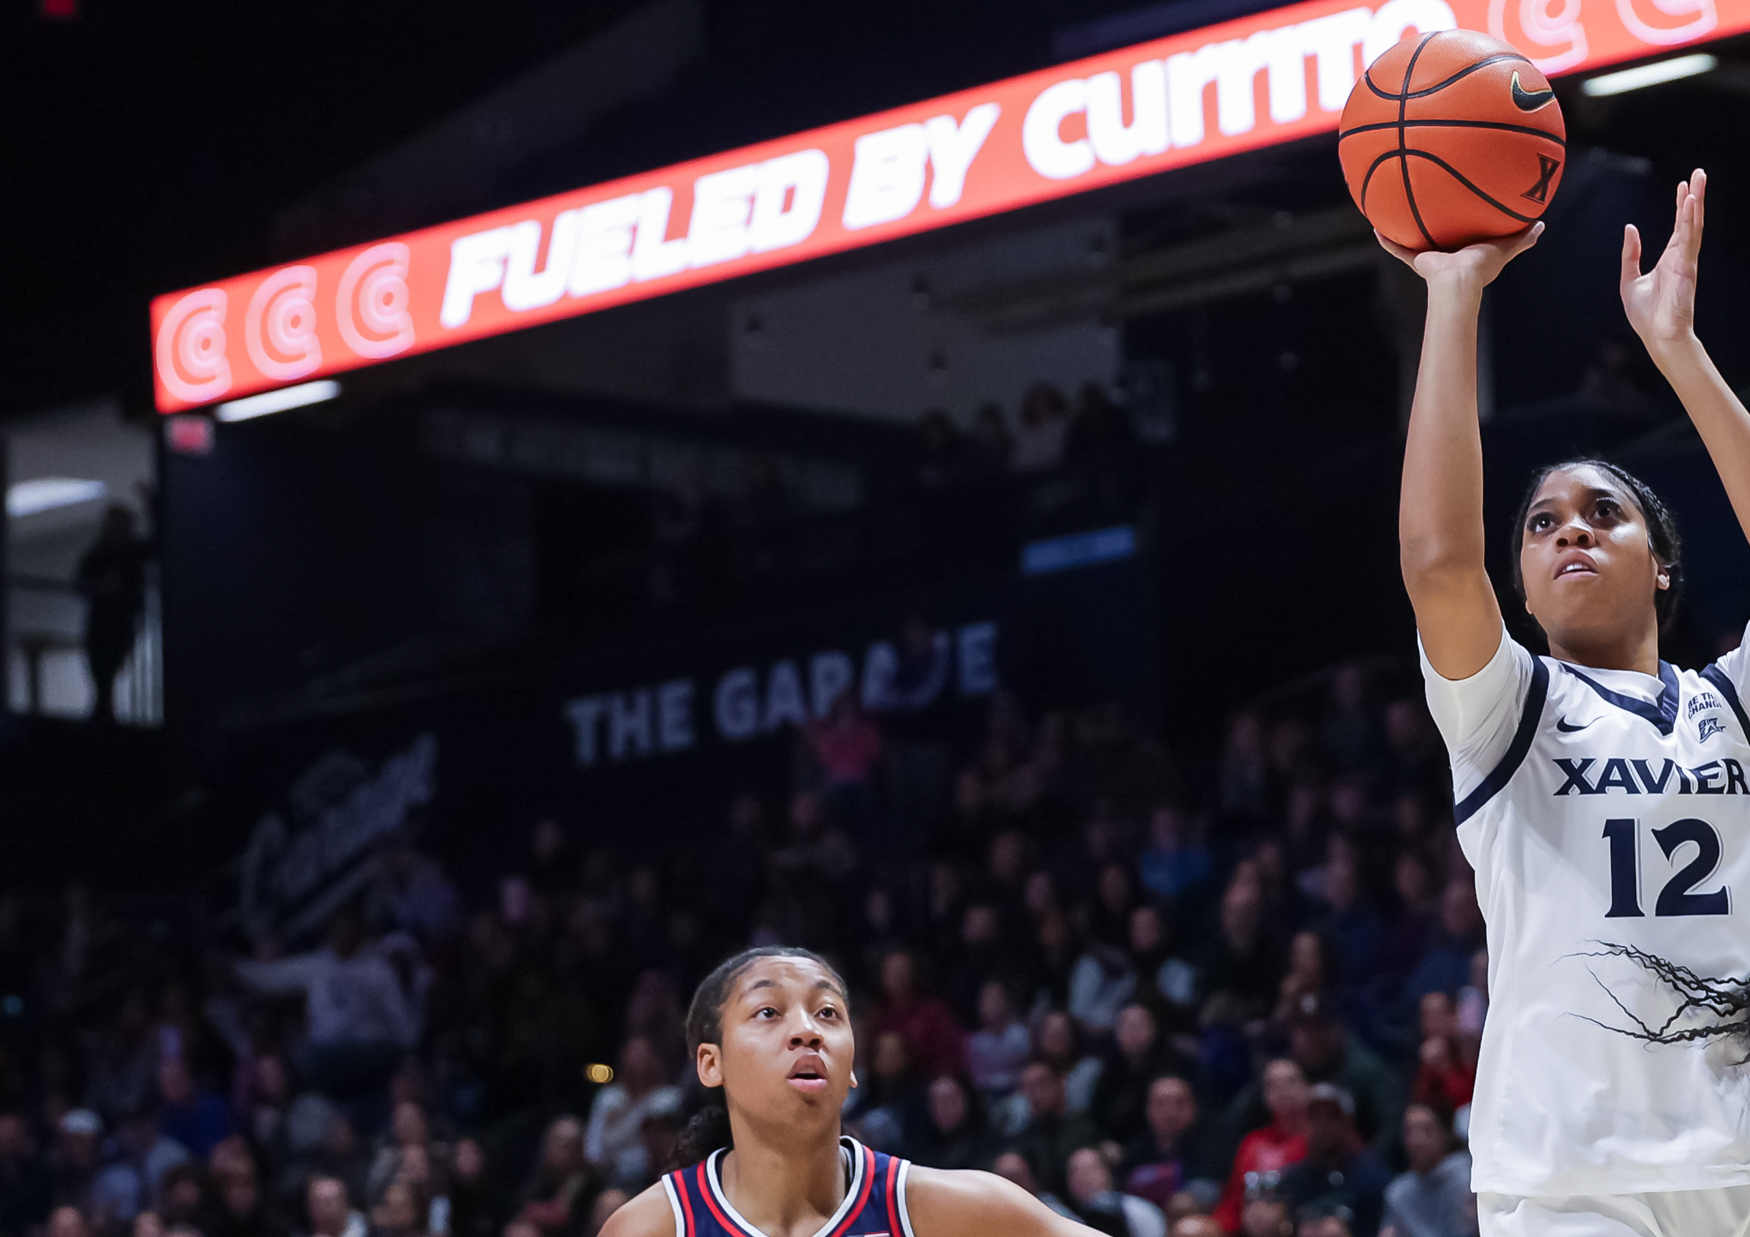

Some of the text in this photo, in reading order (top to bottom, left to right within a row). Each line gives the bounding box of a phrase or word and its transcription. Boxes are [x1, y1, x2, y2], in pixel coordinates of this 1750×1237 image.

[440, 148, 830, 328] FUELED
[842, 102, 1000, 230] BY
[564, 677, 696, 766] THE
[1552, 758, 1750, 796] XAVIER
[1601, 818, 1733, 918] 12
